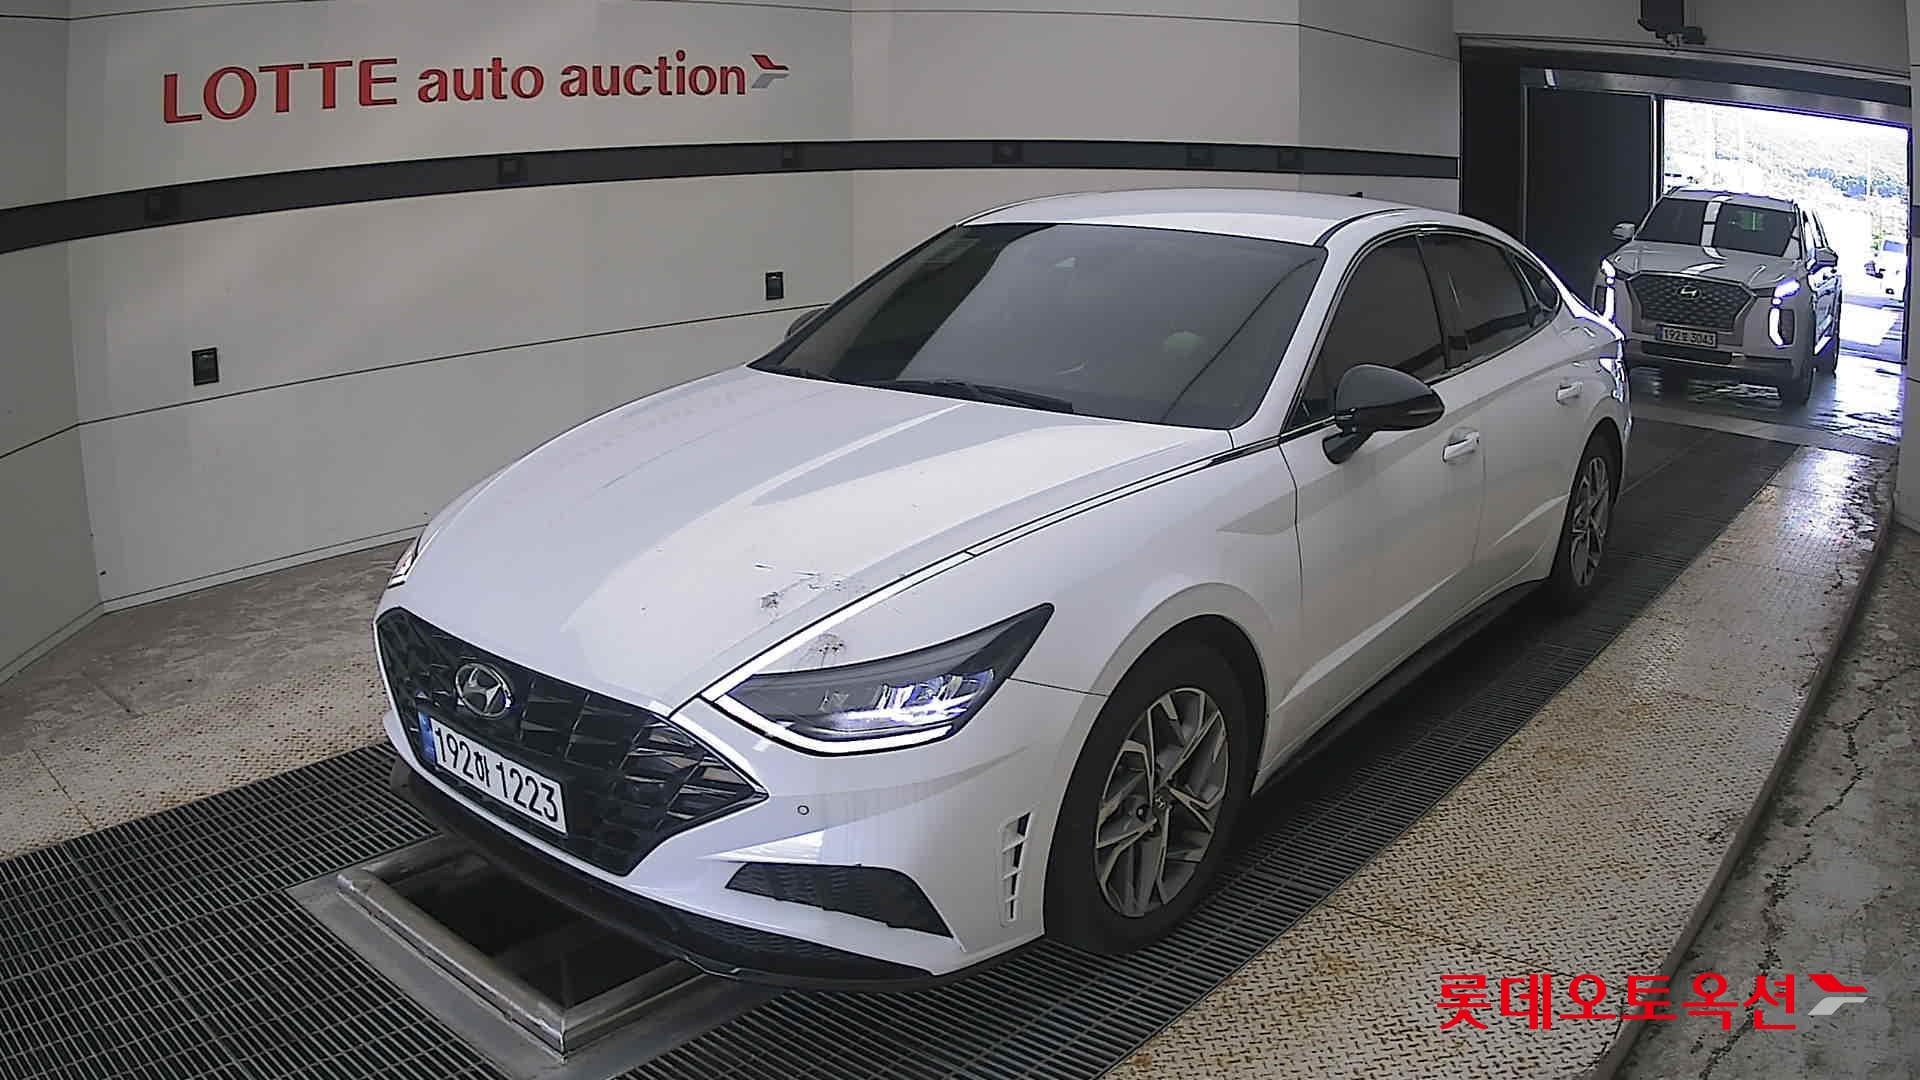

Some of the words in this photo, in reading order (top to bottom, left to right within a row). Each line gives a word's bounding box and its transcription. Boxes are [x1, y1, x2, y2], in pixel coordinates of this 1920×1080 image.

[163, 58, 398, 123] LOTTE
[417, 56, 544, 102] auto
[559, 50, 747, 96] auction
[434, 727, 491, 788] 192하
[495, 760, 558, 822] 1223
